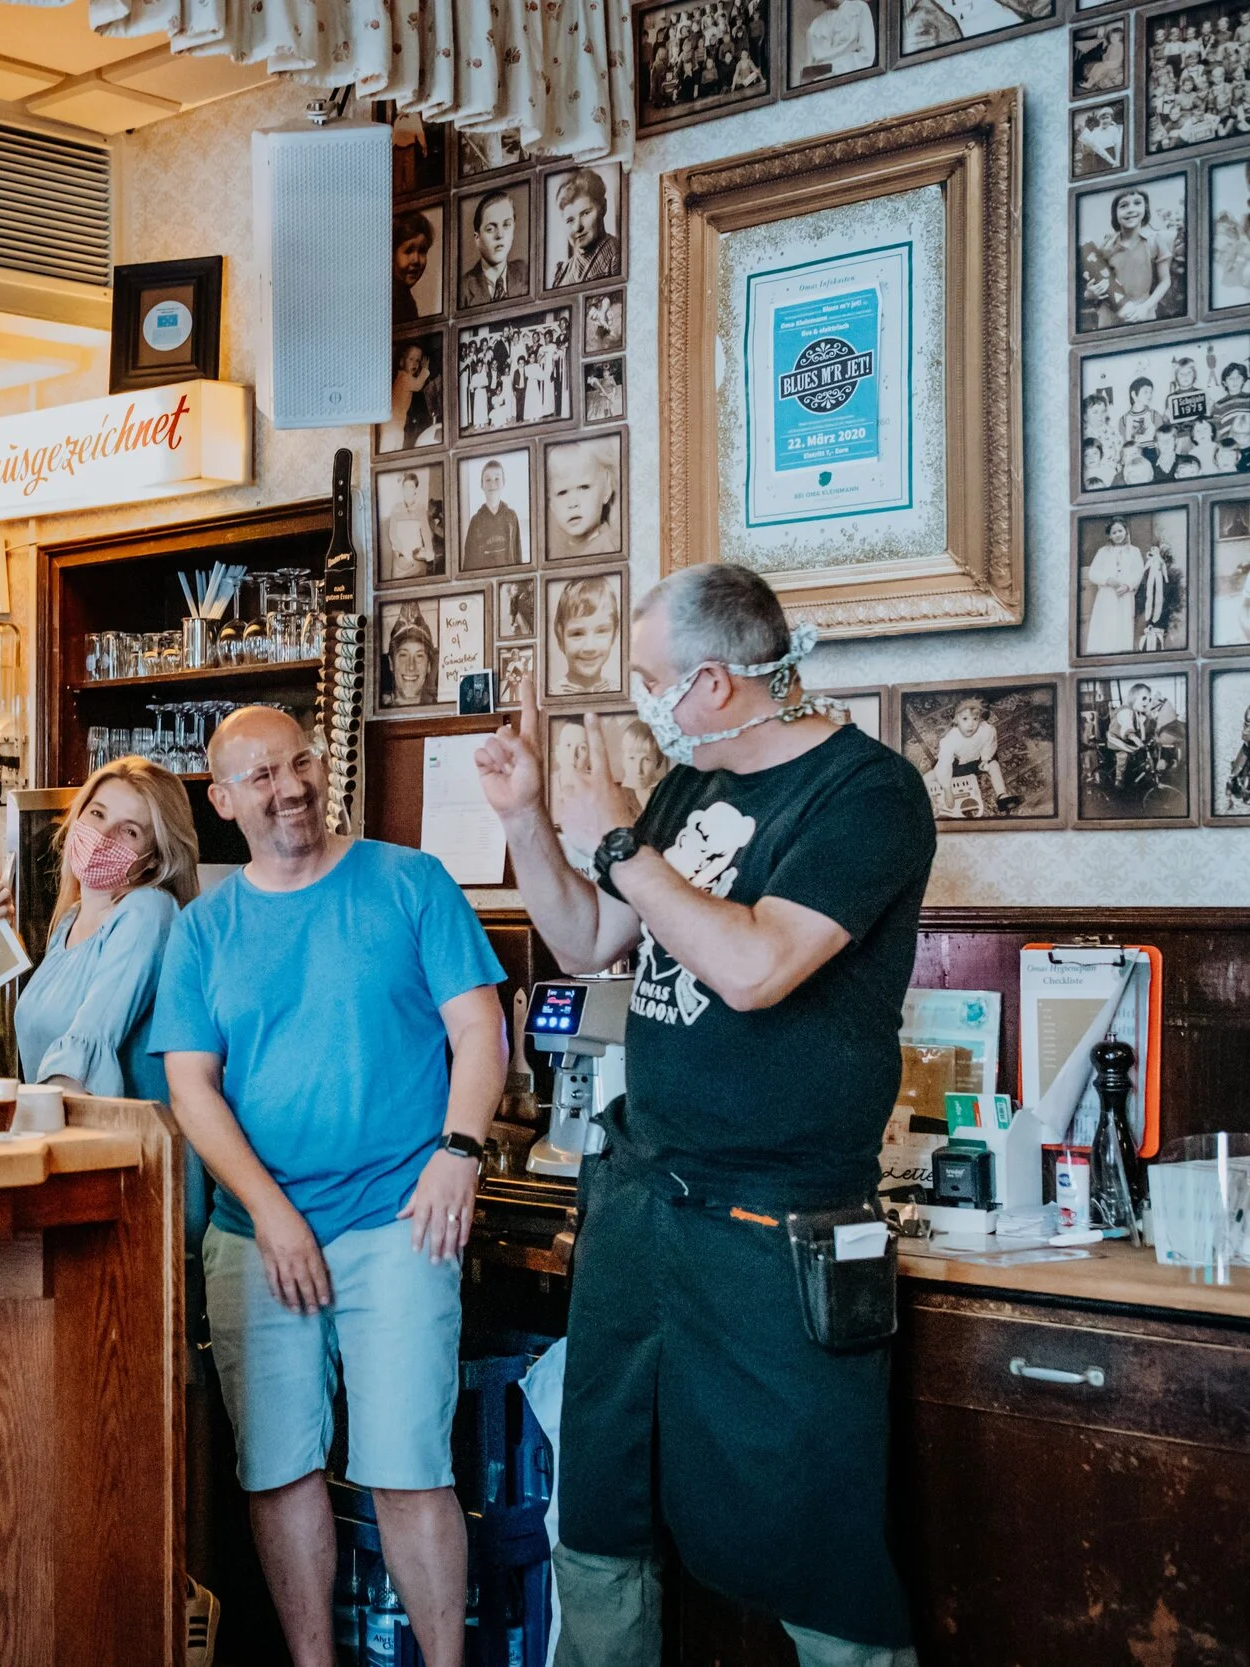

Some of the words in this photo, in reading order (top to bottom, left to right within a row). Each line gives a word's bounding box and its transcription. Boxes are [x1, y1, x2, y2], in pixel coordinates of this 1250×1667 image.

[783, 370, 818, 395] BLUES
[845, 355, 870, 378] JET!
[787, 438, 805, 450] 22.
[807, 433, 835, 447] März
[838, 427, 866, 442] 2020
[805, 490, 820, 498] OMA
[821, 486, 859, 496] KLEINMANN
[445, 617, 469, 632] King
[451, 632, 461, 649] of
[1043, 976, 1084, 985] Checkliste
[639, 981, 672, 1002] OMAS
